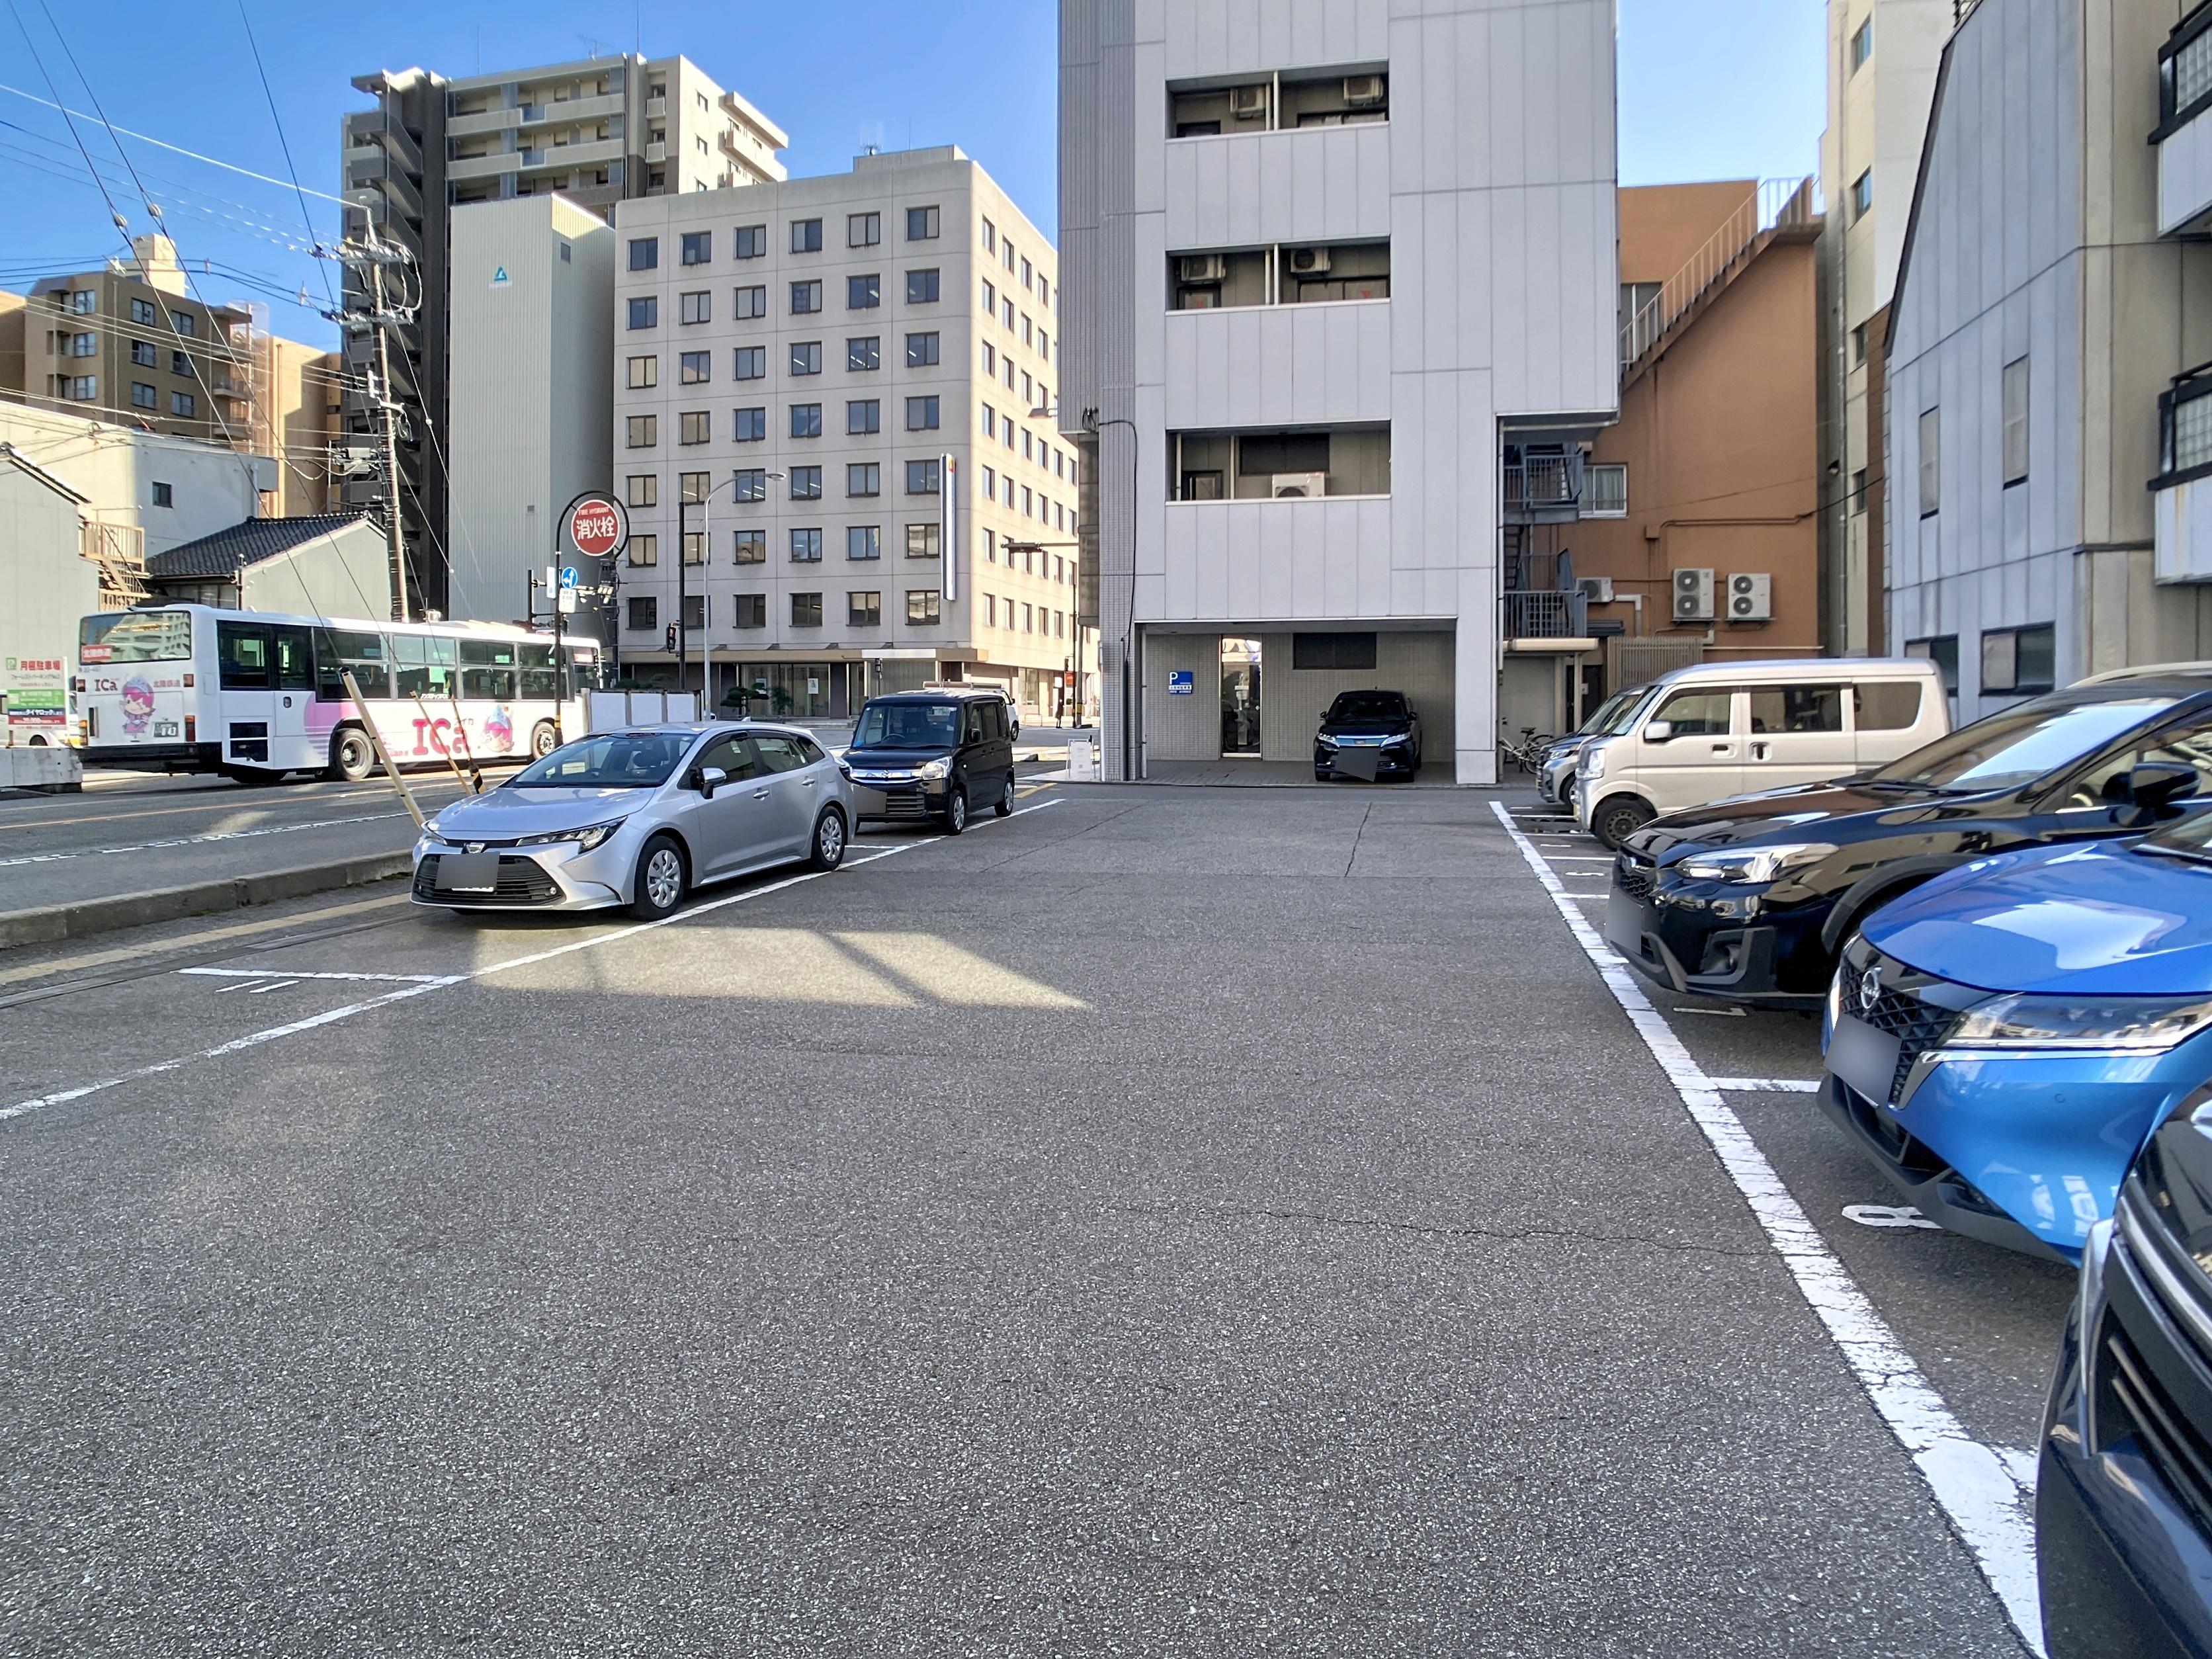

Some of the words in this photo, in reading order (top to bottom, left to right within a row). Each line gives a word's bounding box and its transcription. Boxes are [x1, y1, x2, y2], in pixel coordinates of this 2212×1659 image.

[575, 515, 615, 540] 消火栓
[94, 678, 118, 691] ICa
[1170, 671, 1178, 685] P
[411, 718, 471, 755] ICa
